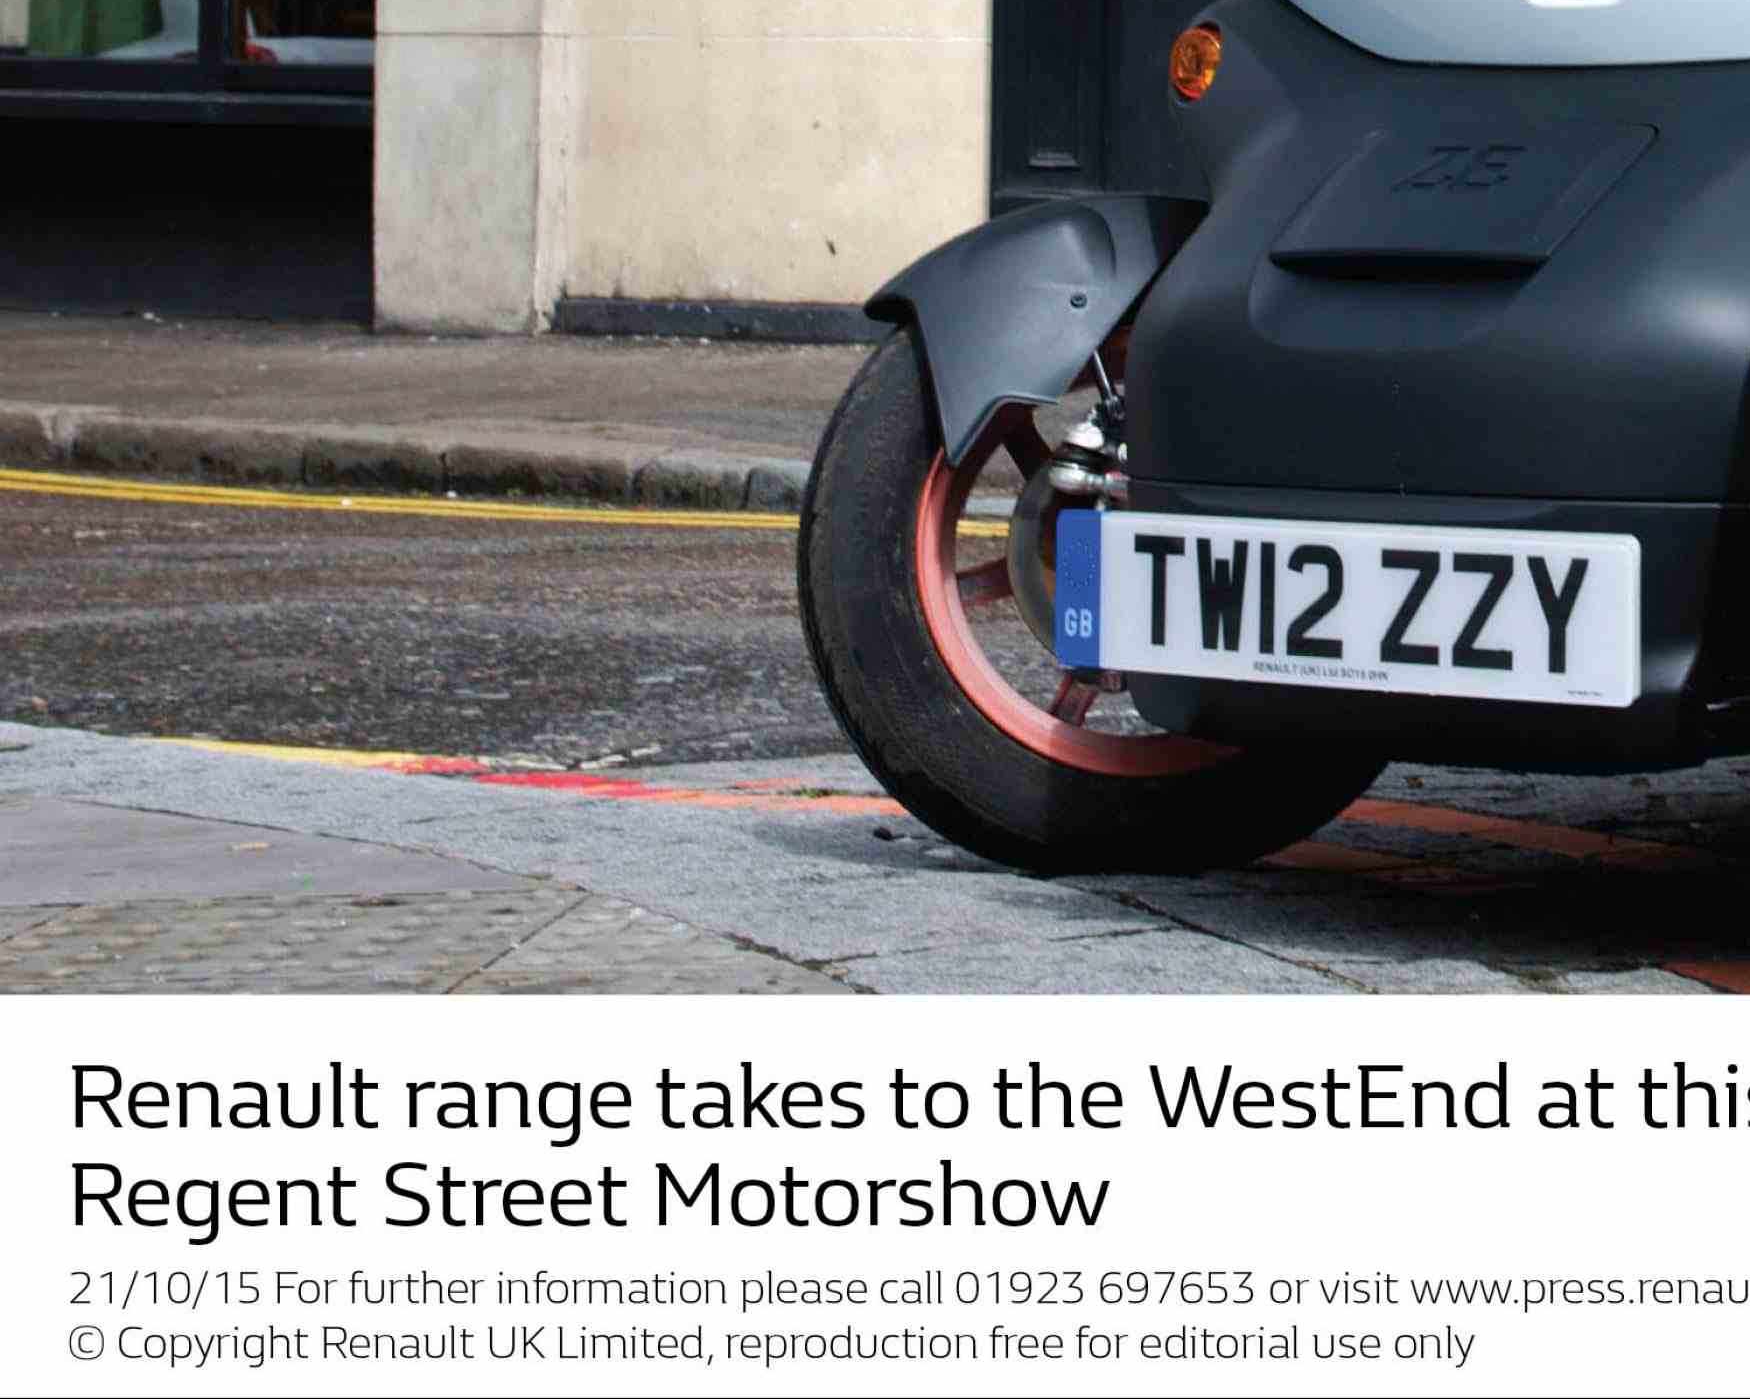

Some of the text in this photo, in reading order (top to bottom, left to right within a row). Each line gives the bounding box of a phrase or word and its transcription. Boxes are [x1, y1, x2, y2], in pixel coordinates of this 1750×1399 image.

[1063, 607, 1093, 639] GB
[1134, 533, 1590, 674] TW12 ZZY
